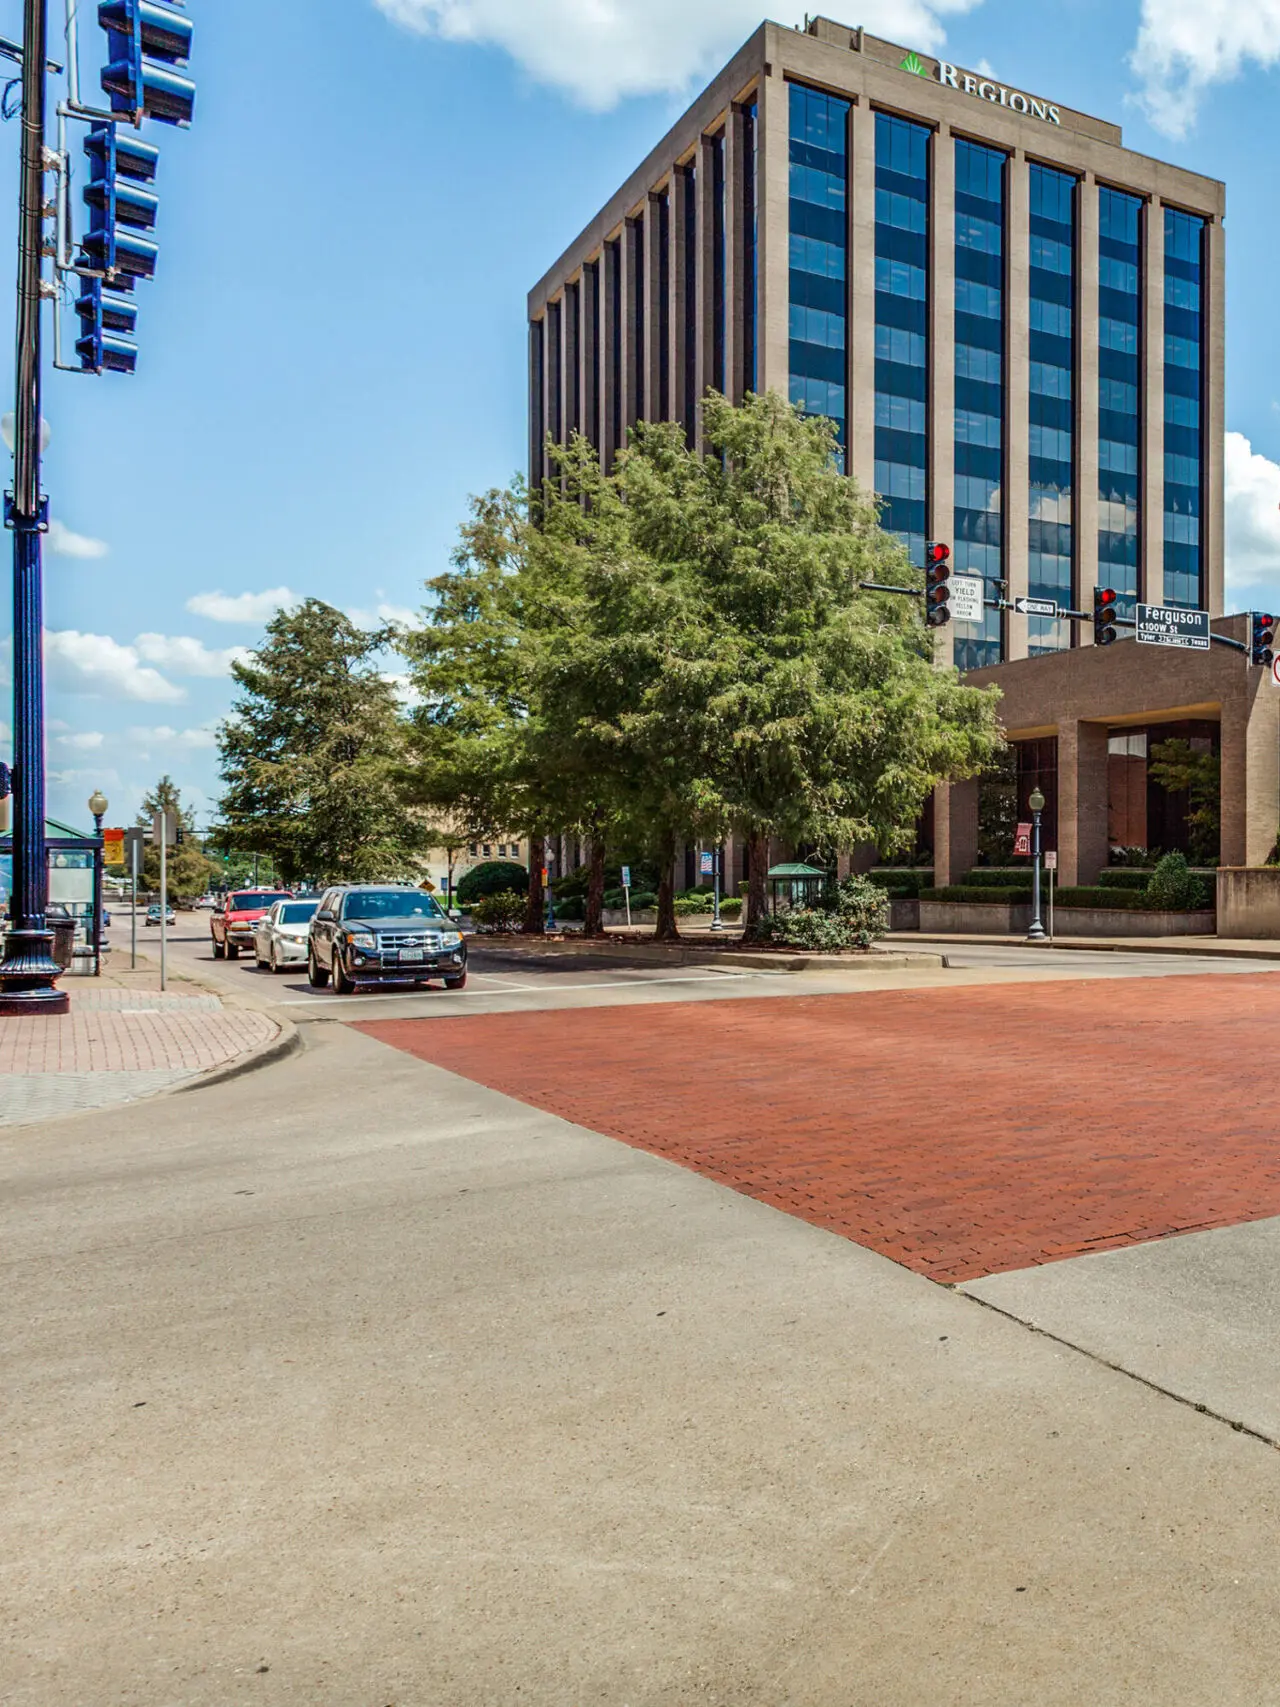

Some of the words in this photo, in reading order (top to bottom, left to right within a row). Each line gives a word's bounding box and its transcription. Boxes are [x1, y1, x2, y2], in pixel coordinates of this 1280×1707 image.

[937, 59, 1061, 125] REGIONS
[955, 587, 975, 596] YIELD
[1145, 607, 1202, 626] Ferguson
[1145, 622, 1167, 632] 100W
[1169, 625, 1178, 634] St
